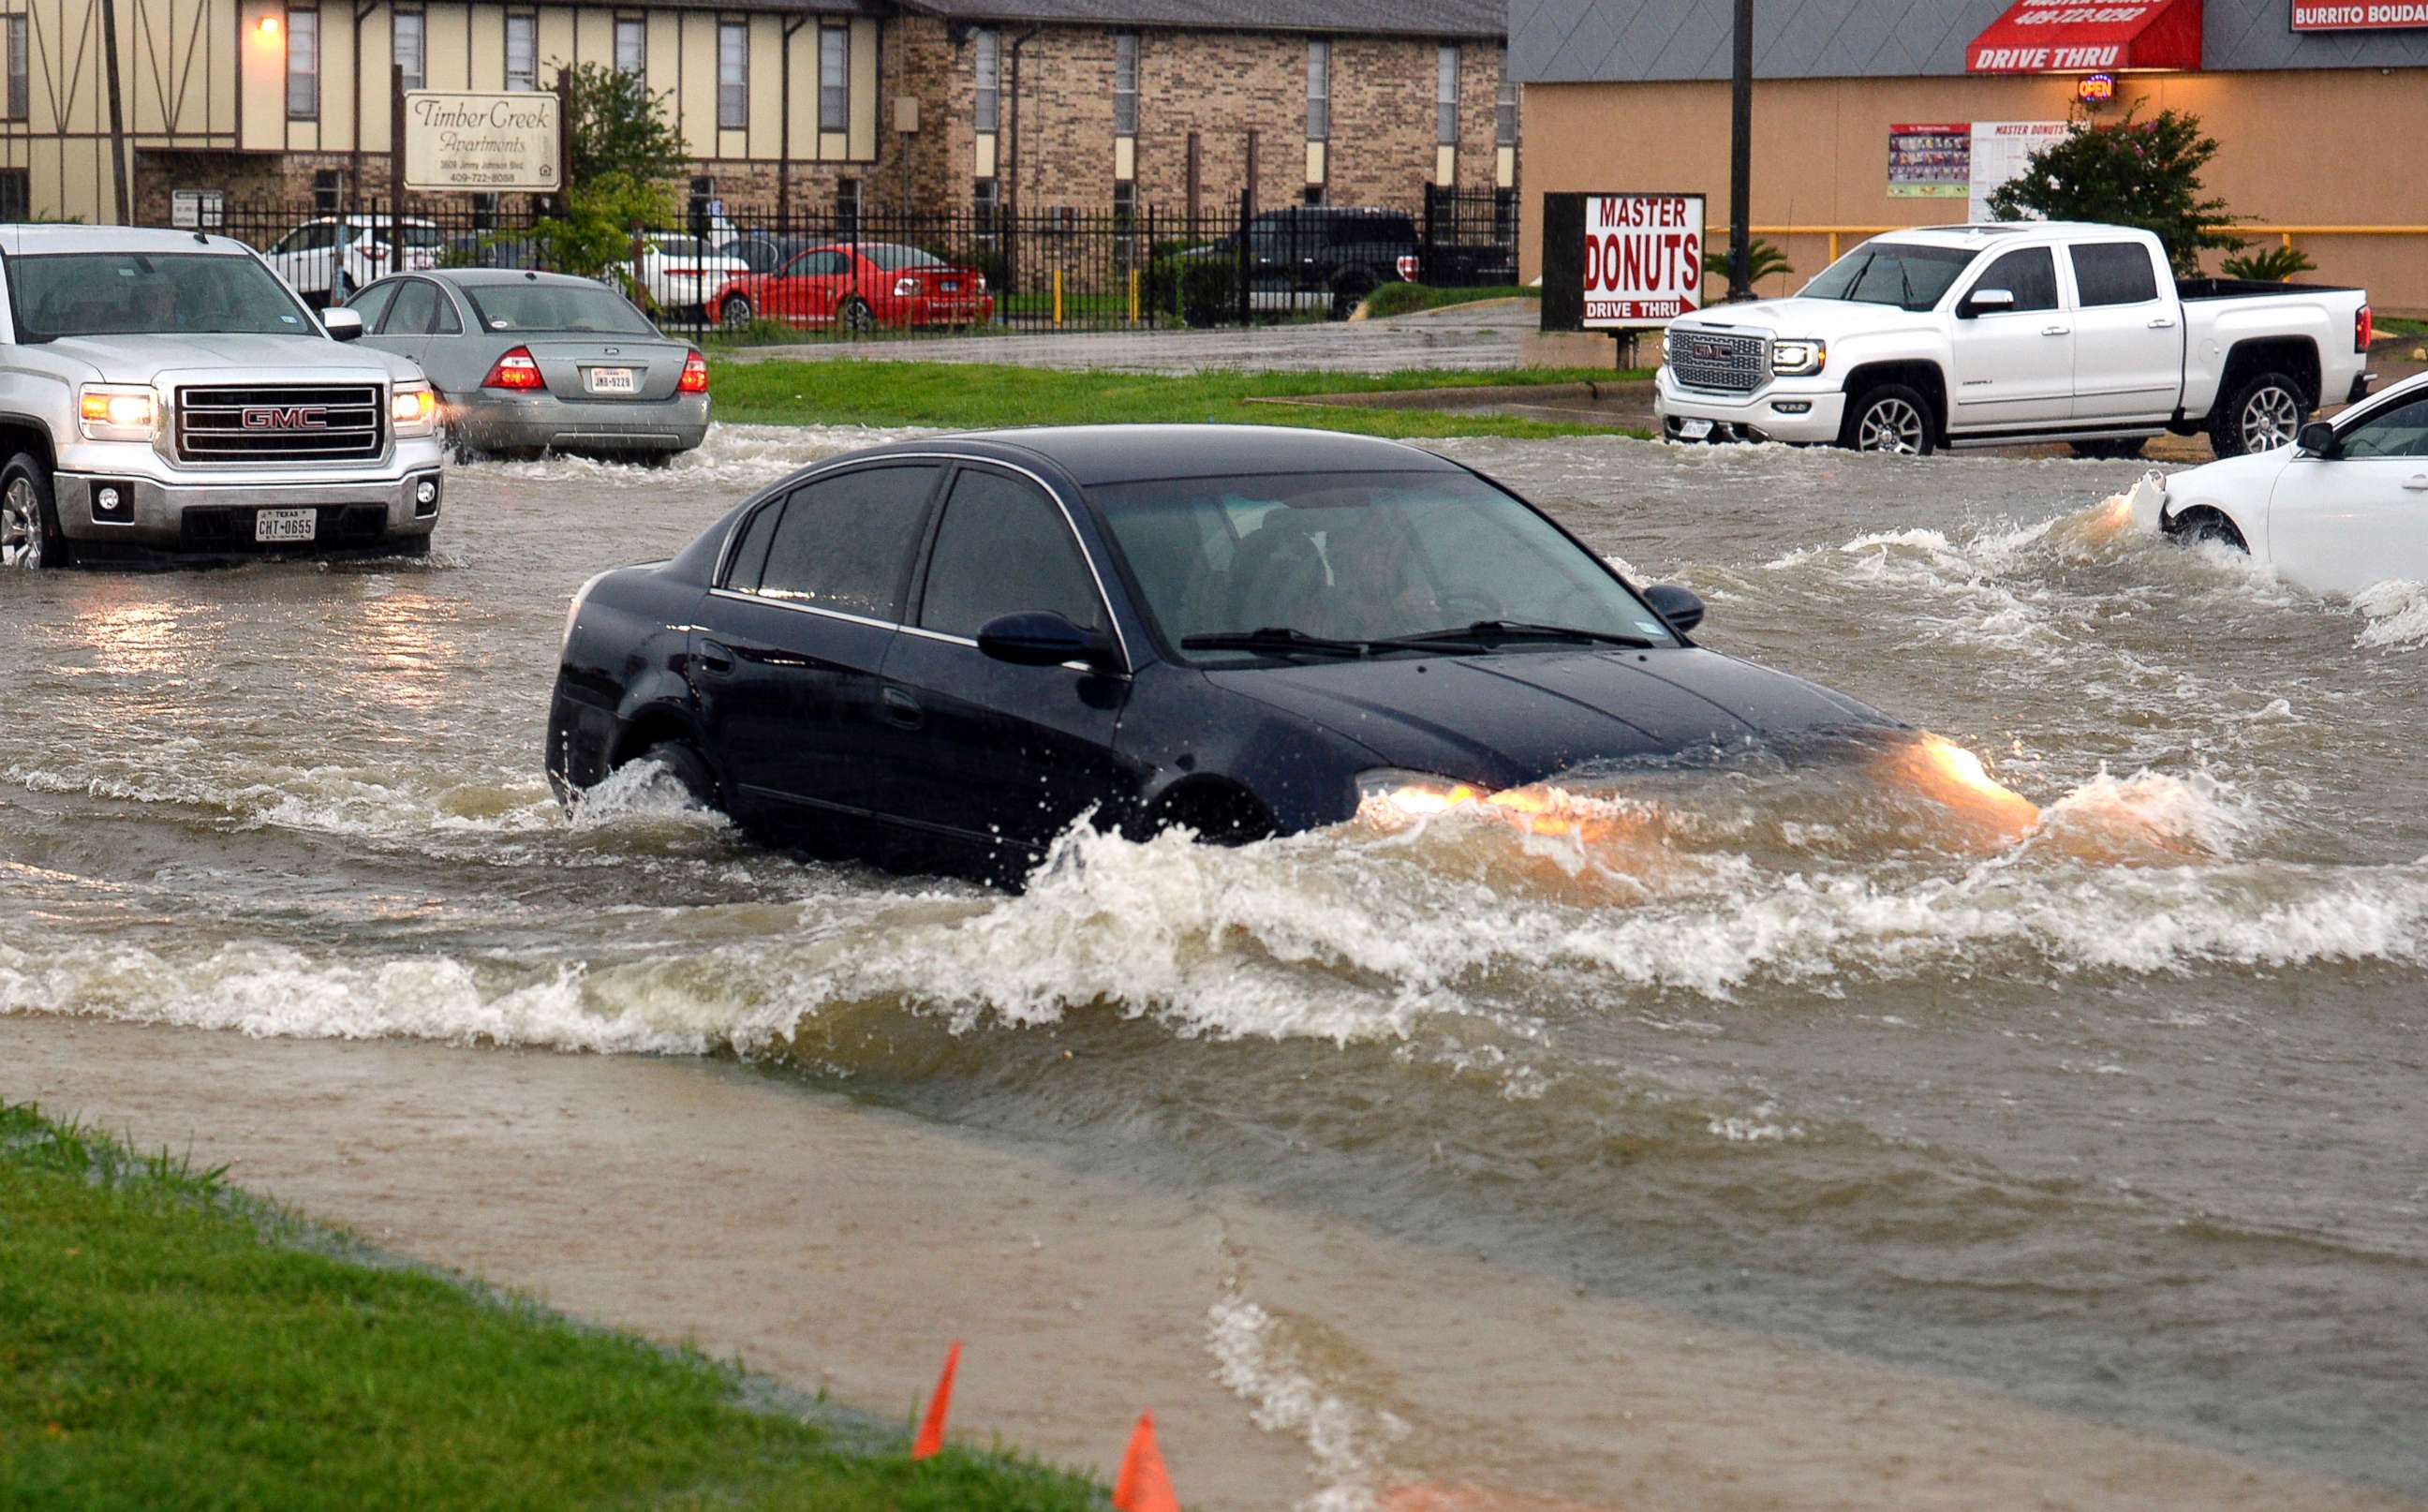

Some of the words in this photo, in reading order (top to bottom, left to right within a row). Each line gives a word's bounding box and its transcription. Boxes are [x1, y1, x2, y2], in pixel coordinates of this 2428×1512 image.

[2295, 7, 2364, 24] BURRITO
[2368, 4, 2428, 23] BOUDA
[1976, 48, 2050, 69] DRIVE
[2052, 46, 2119, 68] THRU
[2079, 80, 2112, 97] OPEN
[414, 99, 487, 128] Timber
[490, 99, 549, 129] Creek
[1995, 125, 2028, 136] MASTER
[2031, 124, 2065, 135] DONUTS
[439, 130, 526, 153] Apartments
[1600, 198, 1687, 227] MASTER
[1584, 233, 1699, 291] DONUTS
[1586, 302, 1632, 318] DRIVE
[1639, 301, 1680, 317] THRU
[1693, 343, 1732, 360] GMC
[242, 407, 328, 429] GMC
